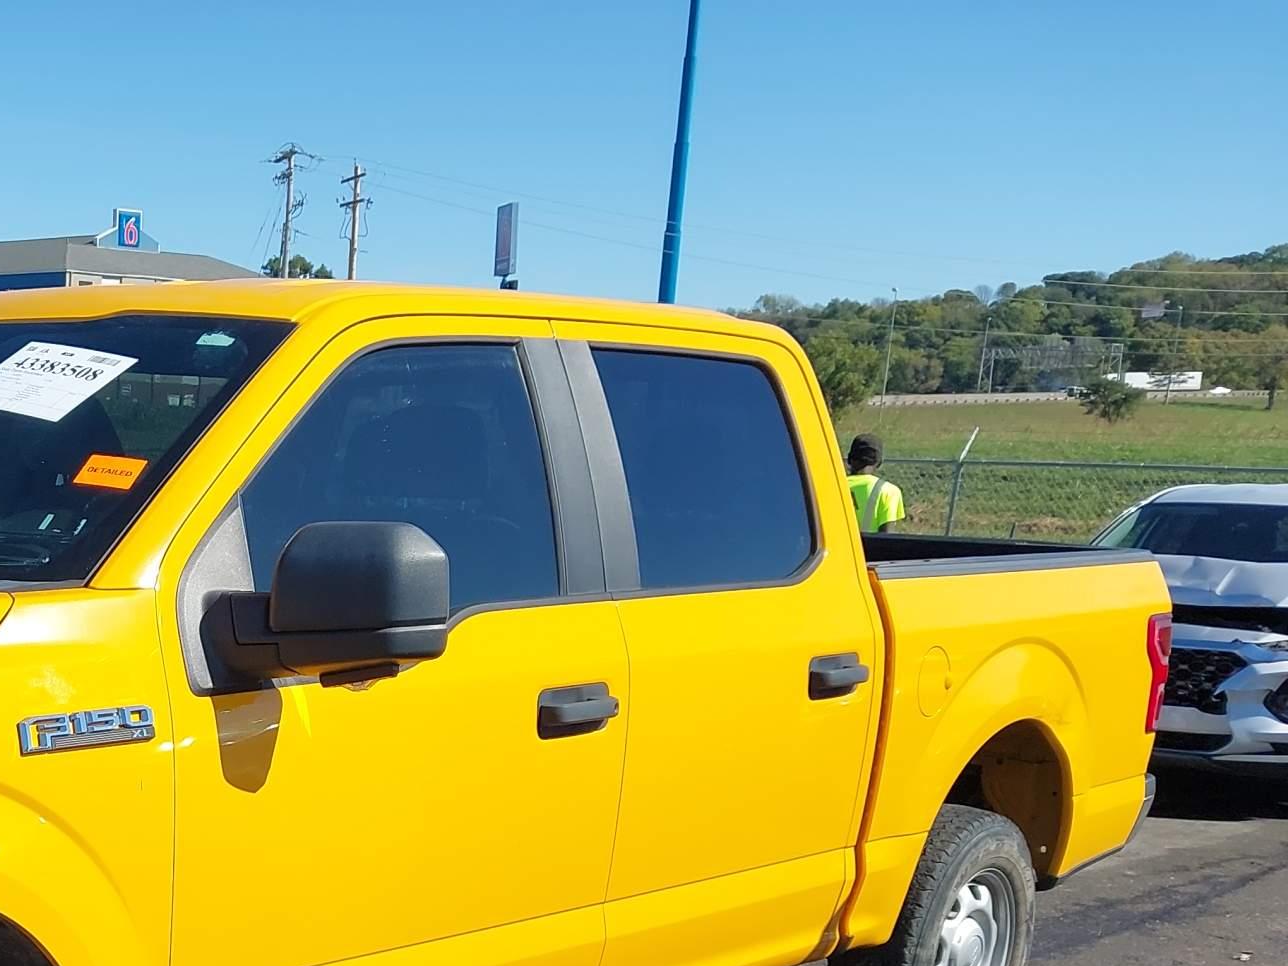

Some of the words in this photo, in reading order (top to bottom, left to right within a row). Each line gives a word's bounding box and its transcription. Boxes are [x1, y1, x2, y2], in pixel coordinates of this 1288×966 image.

[124, 216, 139, 246] 6
[13, 356, 105, 381] 43383508
[86, 466, 133, 477] DETAILED
[17, 706, 154, 755] F150
[133, 729, 152, 738] XL
